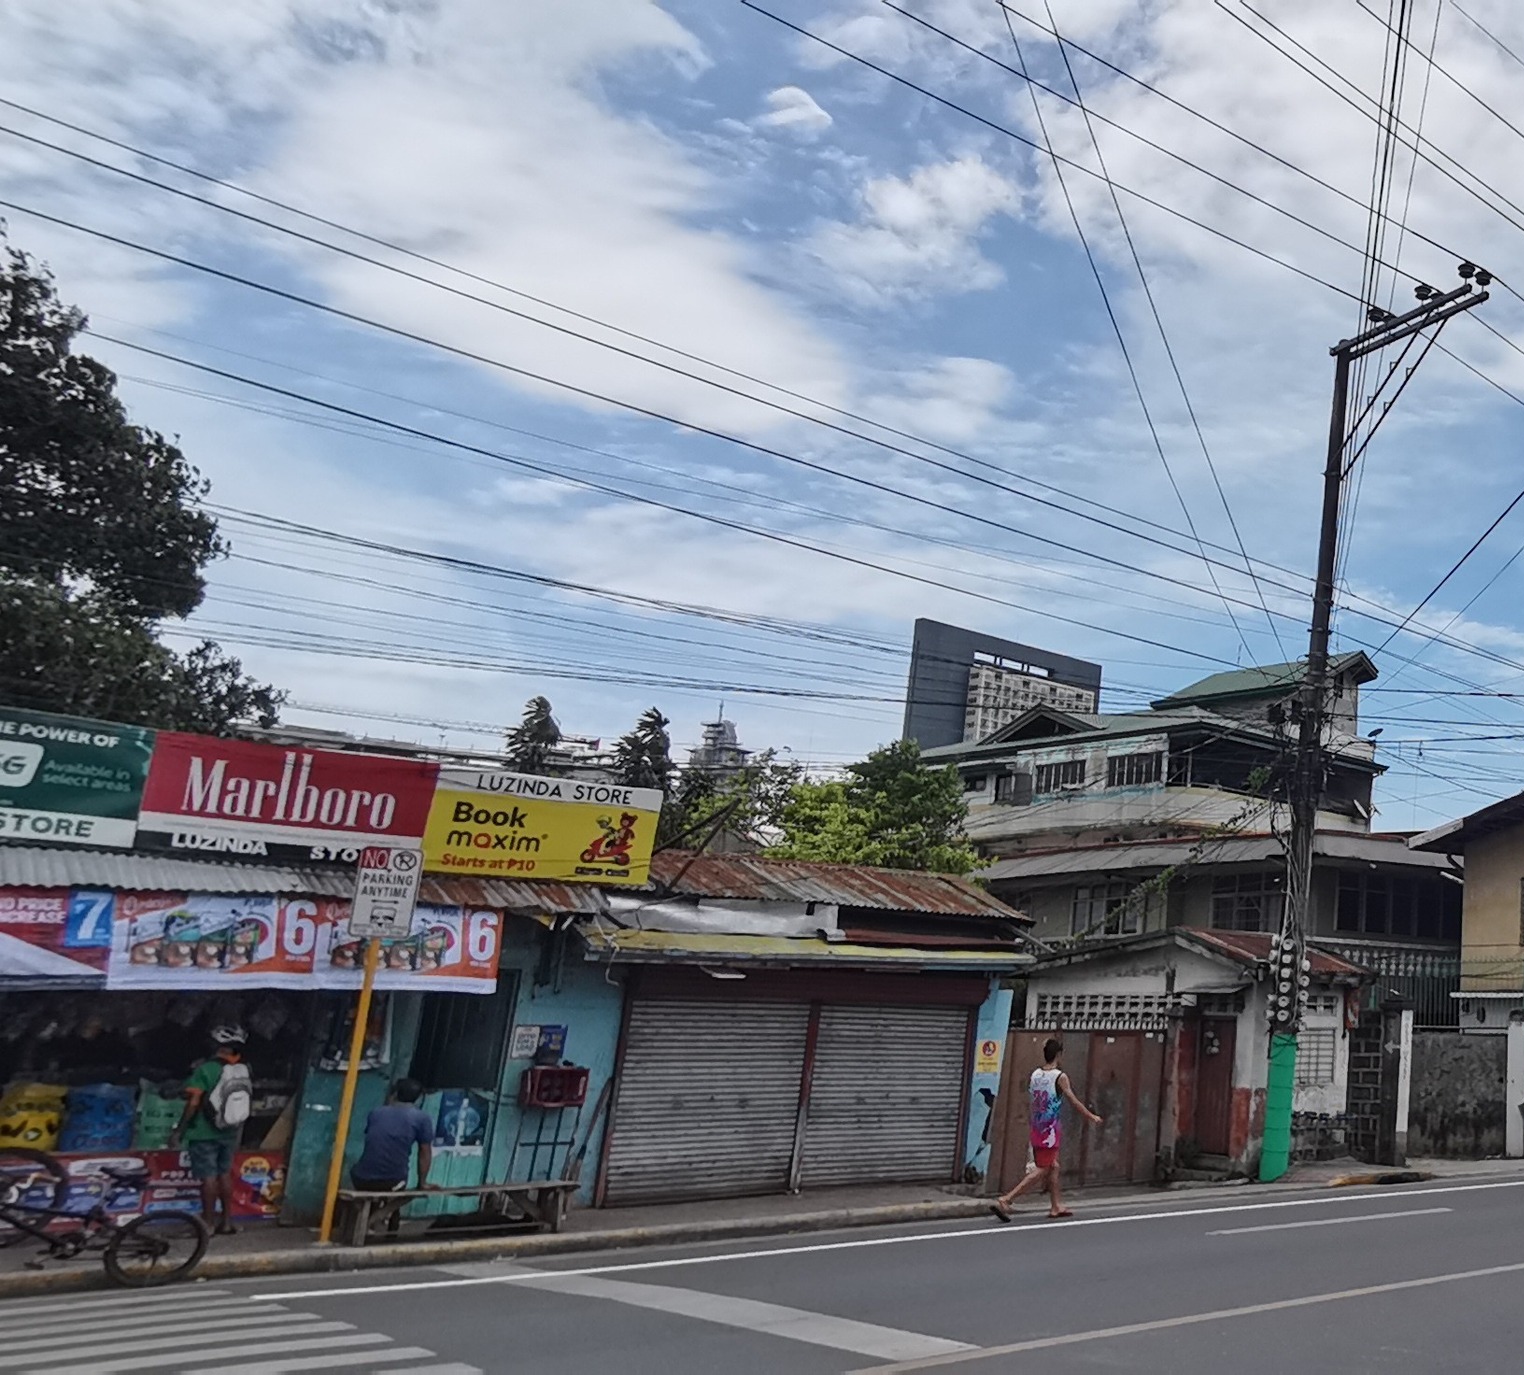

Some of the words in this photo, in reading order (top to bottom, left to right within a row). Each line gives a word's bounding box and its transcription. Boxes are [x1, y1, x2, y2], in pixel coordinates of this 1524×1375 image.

[18, 723, 91, 745] POWER
[93, 734, 120, 748] OF
[44, 760, 114, 778] Available
[181, 751, 396, 830] Marlboro
[477, 774, 562, 798] LUZINDA
[573, 784, 633, 805] STORE
[452, 801, 528, 828] Book
[171, 832, 268, 856] LUZINDA
[310, 846, 359, 862] STO
[446, 829, 540, 852] maxim
[363, 849, 388, 868] NO
[441, 853, 486, 868] Starts
[489, 859, 503, 869] at
[362, 872, 413, 886] PARKING
[361, 885, 408, 899] ANYTIME
